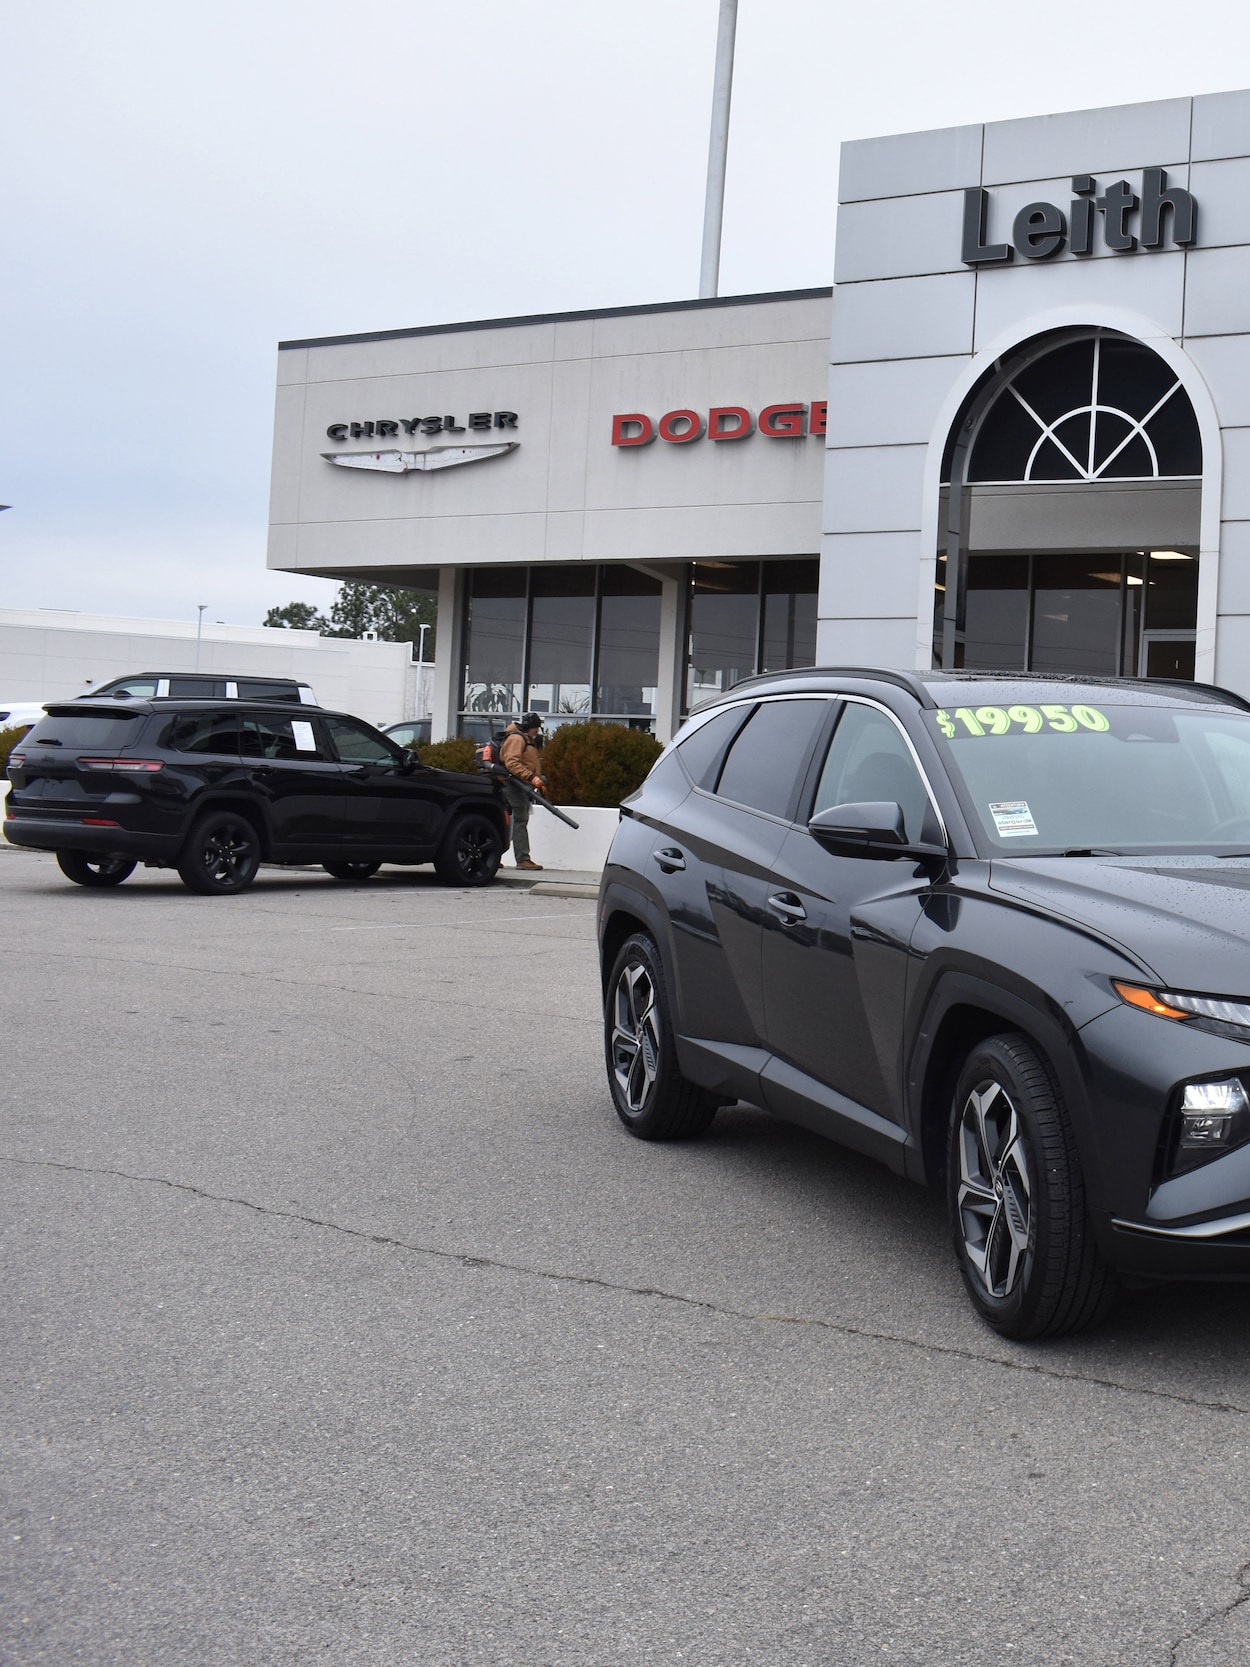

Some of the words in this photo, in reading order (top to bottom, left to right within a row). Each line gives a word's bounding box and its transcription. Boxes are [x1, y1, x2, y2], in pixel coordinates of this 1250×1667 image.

[961, 167, 1198, 266] Leith
[326, 411, 519, 441] CHRYSLER
[935, 704, 1110, 739] $19950
